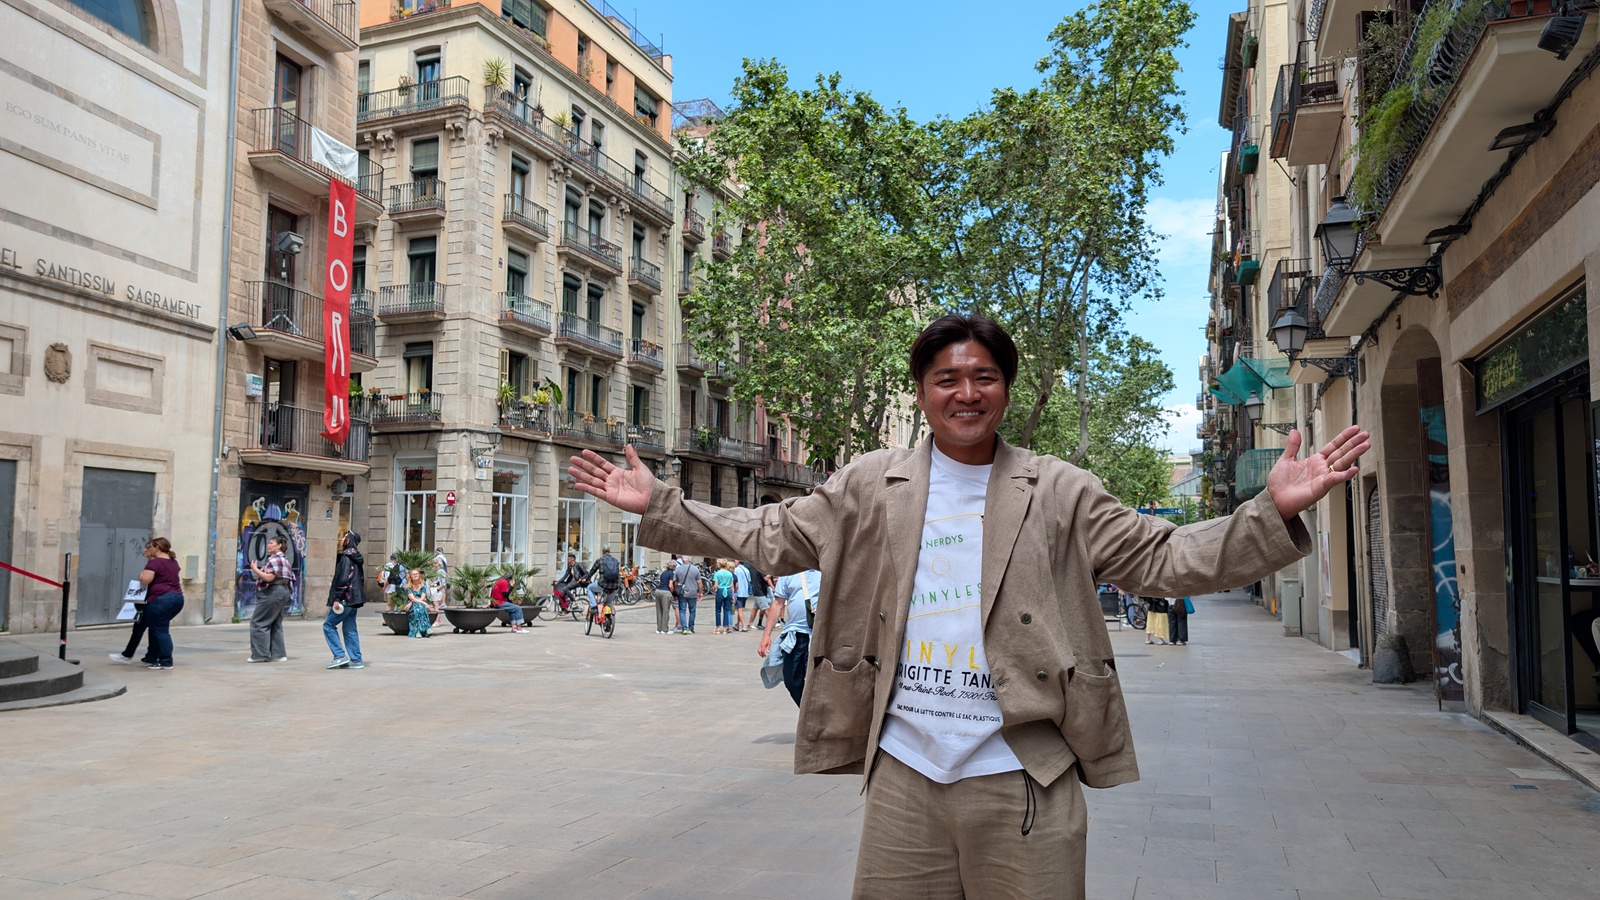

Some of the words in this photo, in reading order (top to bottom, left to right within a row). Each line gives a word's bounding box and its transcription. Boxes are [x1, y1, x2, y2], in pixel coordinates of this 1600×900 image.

[5, 101, 32, 120] EGO
[34, 114, 60, 132] SUM
[63, 127, 97, 148] PANIS
[99, 143, 130, 163] VITAE
[36, 258, 116, 295] SANTISSIM
[126, 285, 201, 319] SAGRAMENT
[925, 534, 964, 549] NERDYS
[907, 639, 980, 669] INYL
[961, 671, 995, 689] TAN
[957, 690, 983, 700] 75001
[903, 705, 914, 713] POUR
[920, 708, 934, 717] LUTTE
[934, 711, 955, 719] CONTRE
[955, 712, 962, 720] LE
[972, 715, 1001, 723] PLASTIQUE
